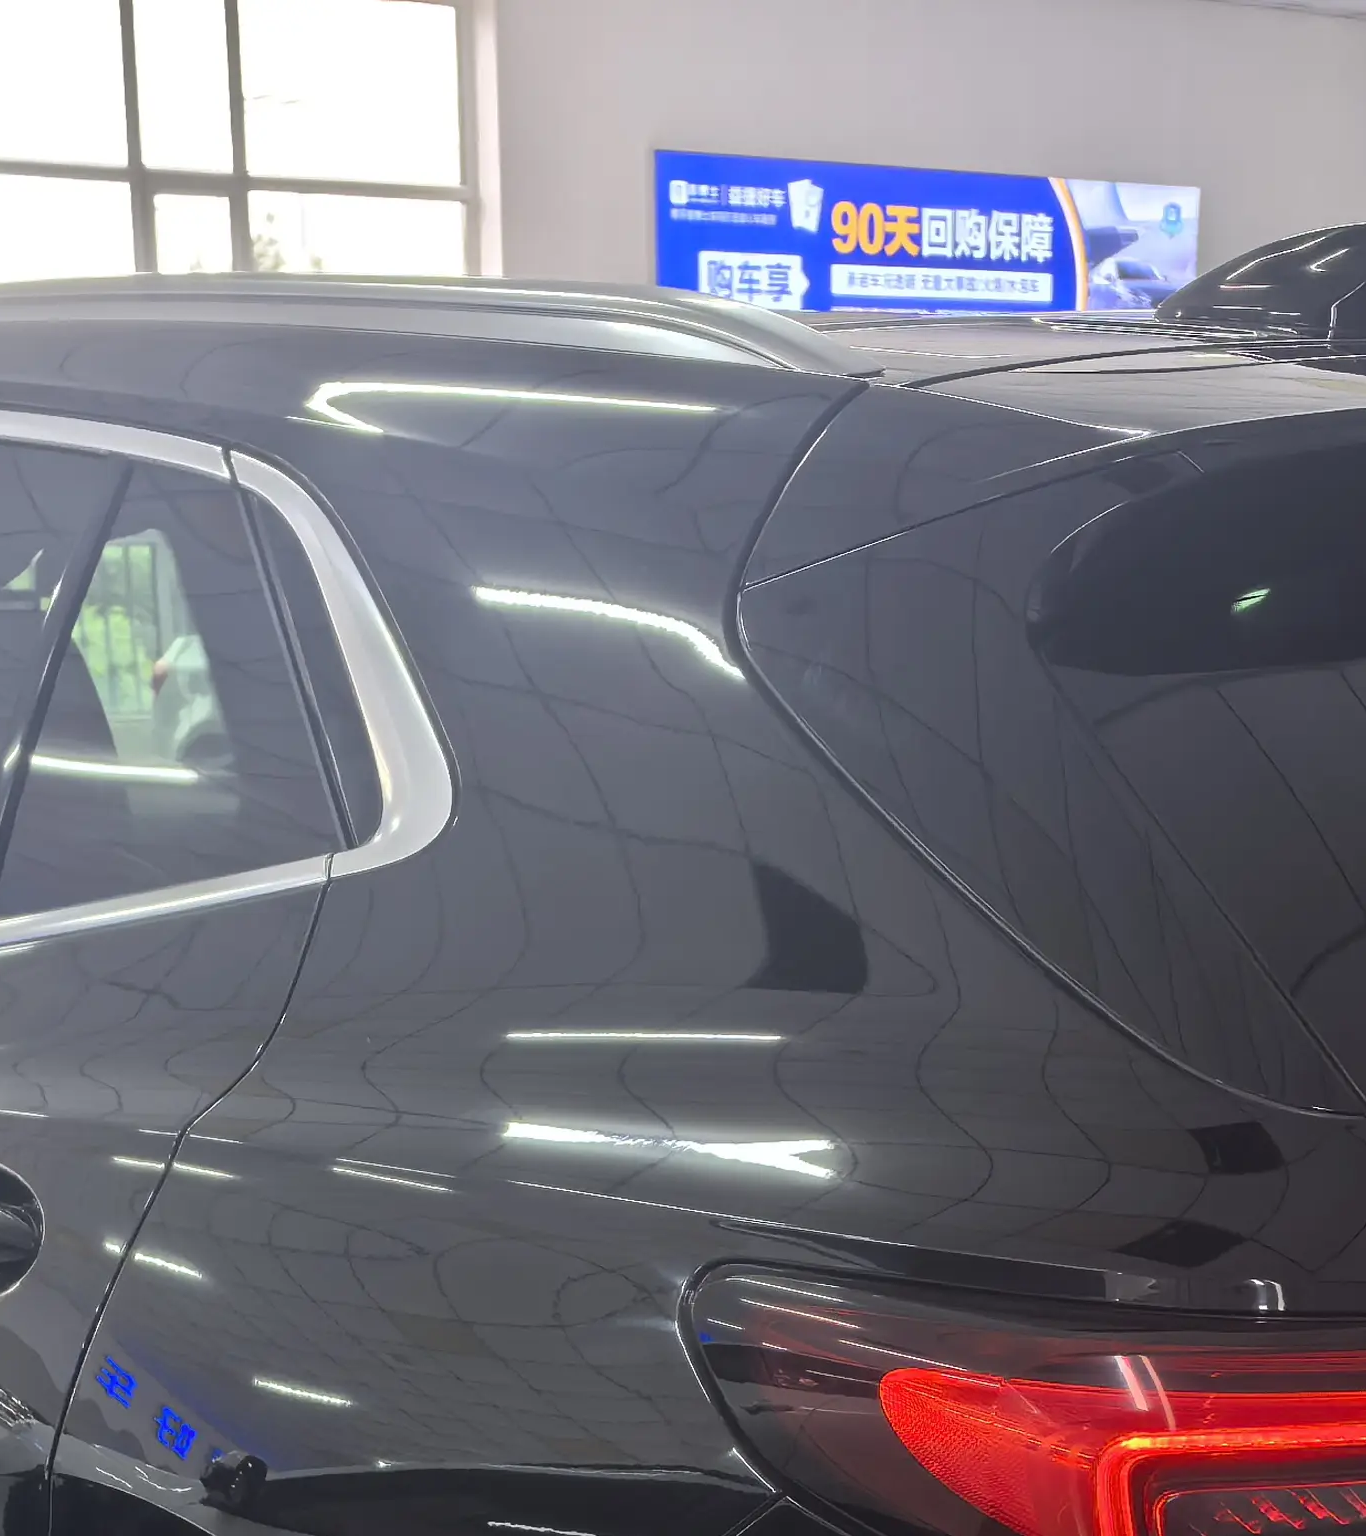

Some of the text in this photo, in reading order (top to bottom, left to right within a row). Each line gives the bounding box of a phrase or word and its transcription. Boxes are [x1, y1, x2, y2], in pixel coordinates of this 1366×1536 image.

[831, 200, 1054, 263] 90天回购保障
[707, 258, 793, 303] 购车享
